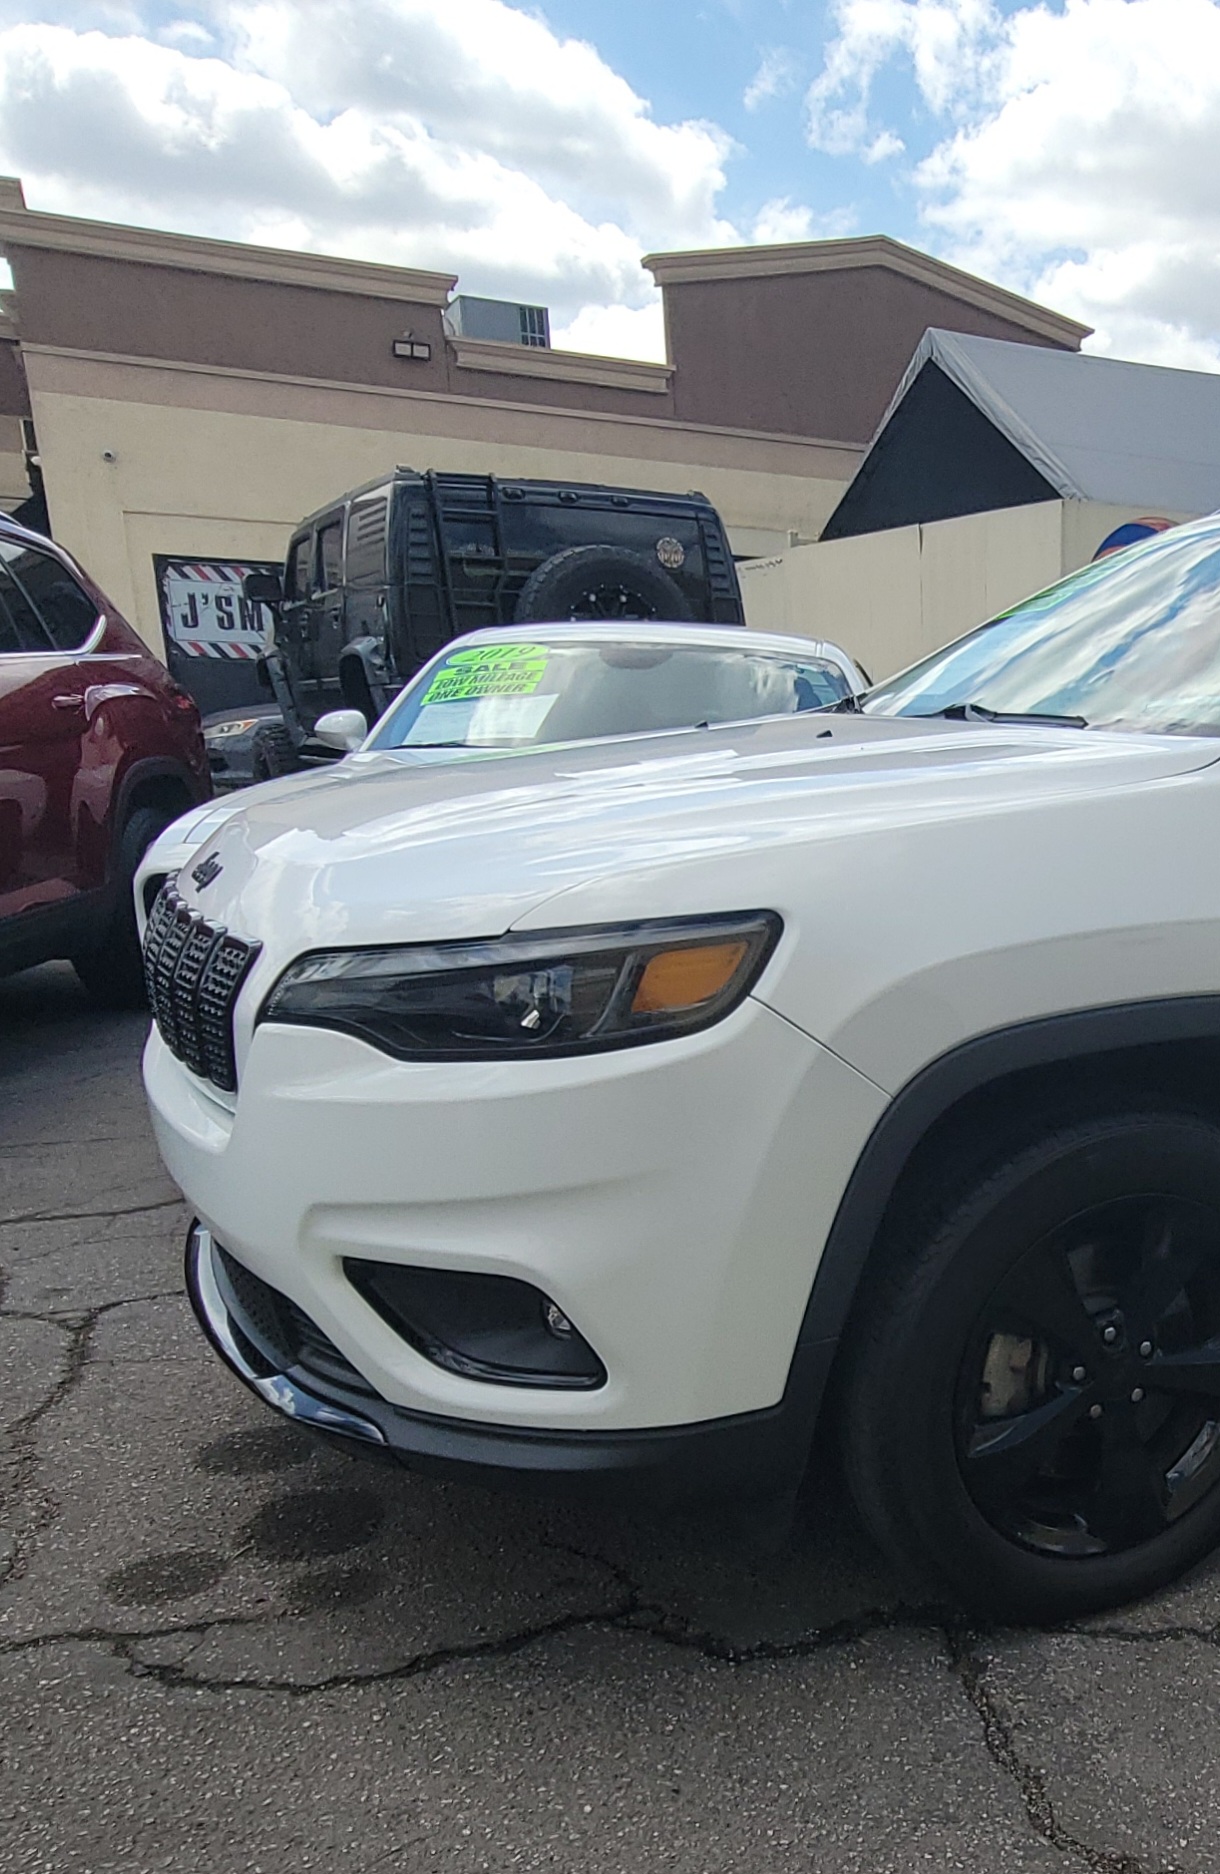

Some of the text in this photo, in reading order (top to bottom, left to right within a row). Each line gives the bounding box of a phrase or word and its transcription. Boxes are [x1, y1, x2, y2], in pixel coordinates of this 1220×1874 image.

[462, 646, 536, 662] 2019
[455, 663, 525, 675] SALE
[436, 671, 534, 690] LOW MILEAGE
[428, 684, 527, 702] ONE OWNER
